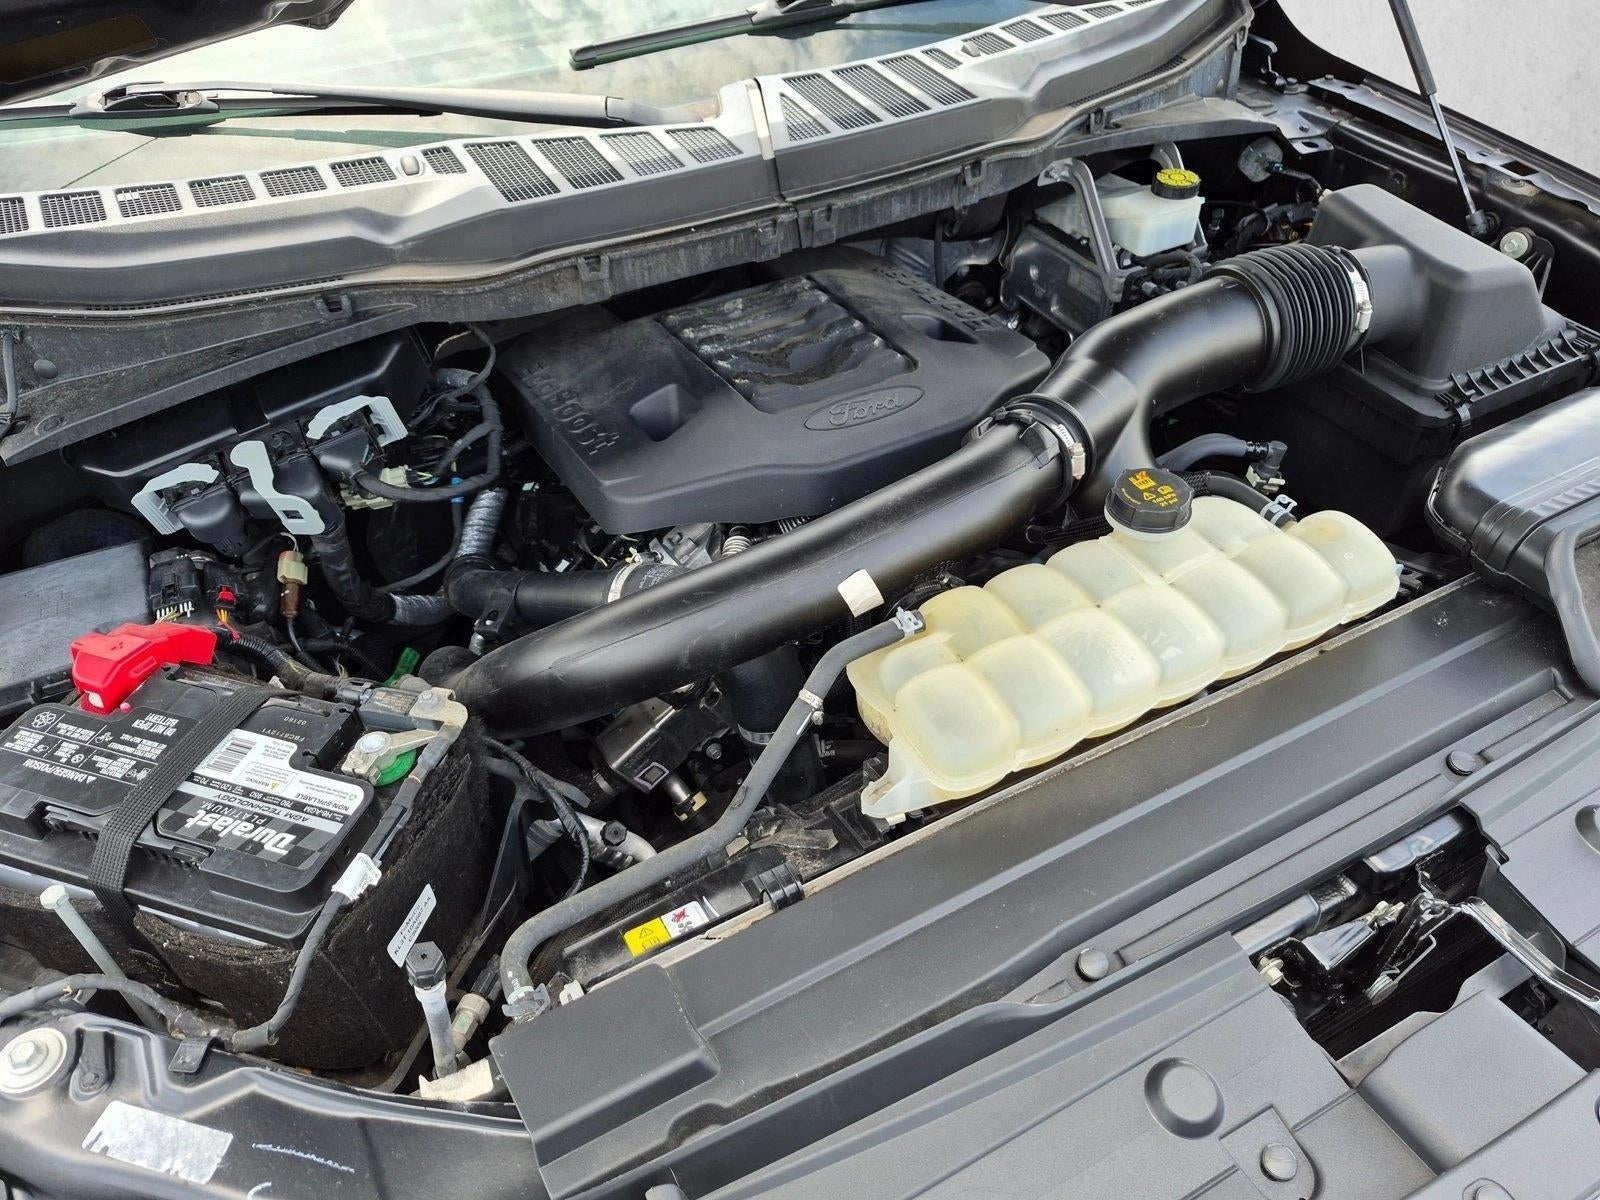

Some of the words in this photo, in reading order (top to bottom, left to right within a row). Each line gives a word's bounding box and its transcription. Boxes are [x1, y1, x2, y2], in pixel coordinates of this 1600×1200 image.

[828, 393, 903, 426] Ford
[131, 719, 153, 729] OPEN
[148, 723, 166, 732] NOT
[162, 727, 178, 736] DO
[23, 759, 86, 783] DANGER/POISON
[200, 777, 210, 785] 70
[214, 793, 284, 816] TECHNOLOGY
[296, 792, 350, 811] NON-SPILLABLE
[201, 801, 267, 824] PLATINUM
[283, 811, 310, 822] AGM
[184, 809, 297, 856] Duralast
